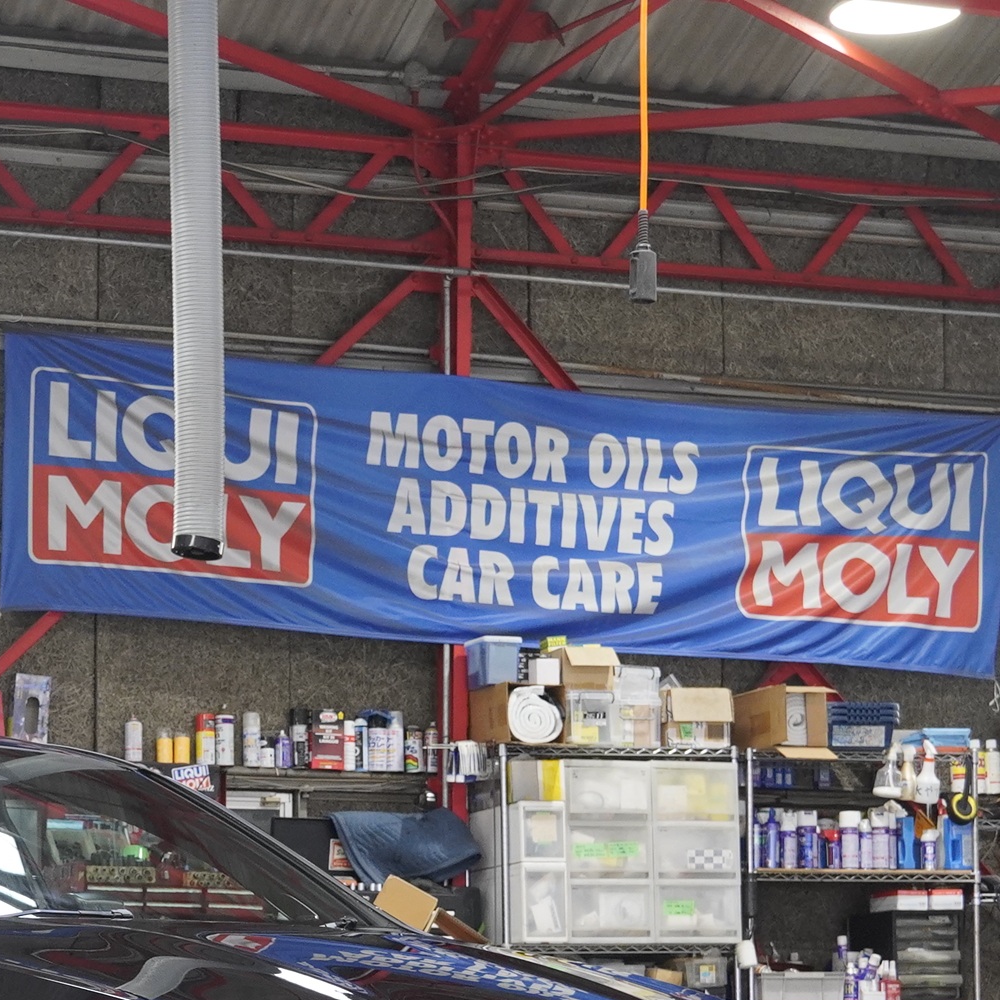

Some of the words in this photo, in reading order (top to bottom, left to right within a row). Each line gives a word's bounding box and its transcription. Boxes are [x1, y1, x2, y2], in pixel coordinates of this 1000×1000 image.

[48, 381, 300, 485] LIQUI
[366, 411, 570, 484] MOTOR
[588, 433, 700, 495] OILS
[387, 477, 675, 557] ADDITIVES
[758, 456, 974, 534] LIQUI
[407, 545, 514, 607] CAR
[531, 556, 663, 615] CARE
[752, 540, 975, 619] MOLY
[174, 765, 207, 780] LIQUI
